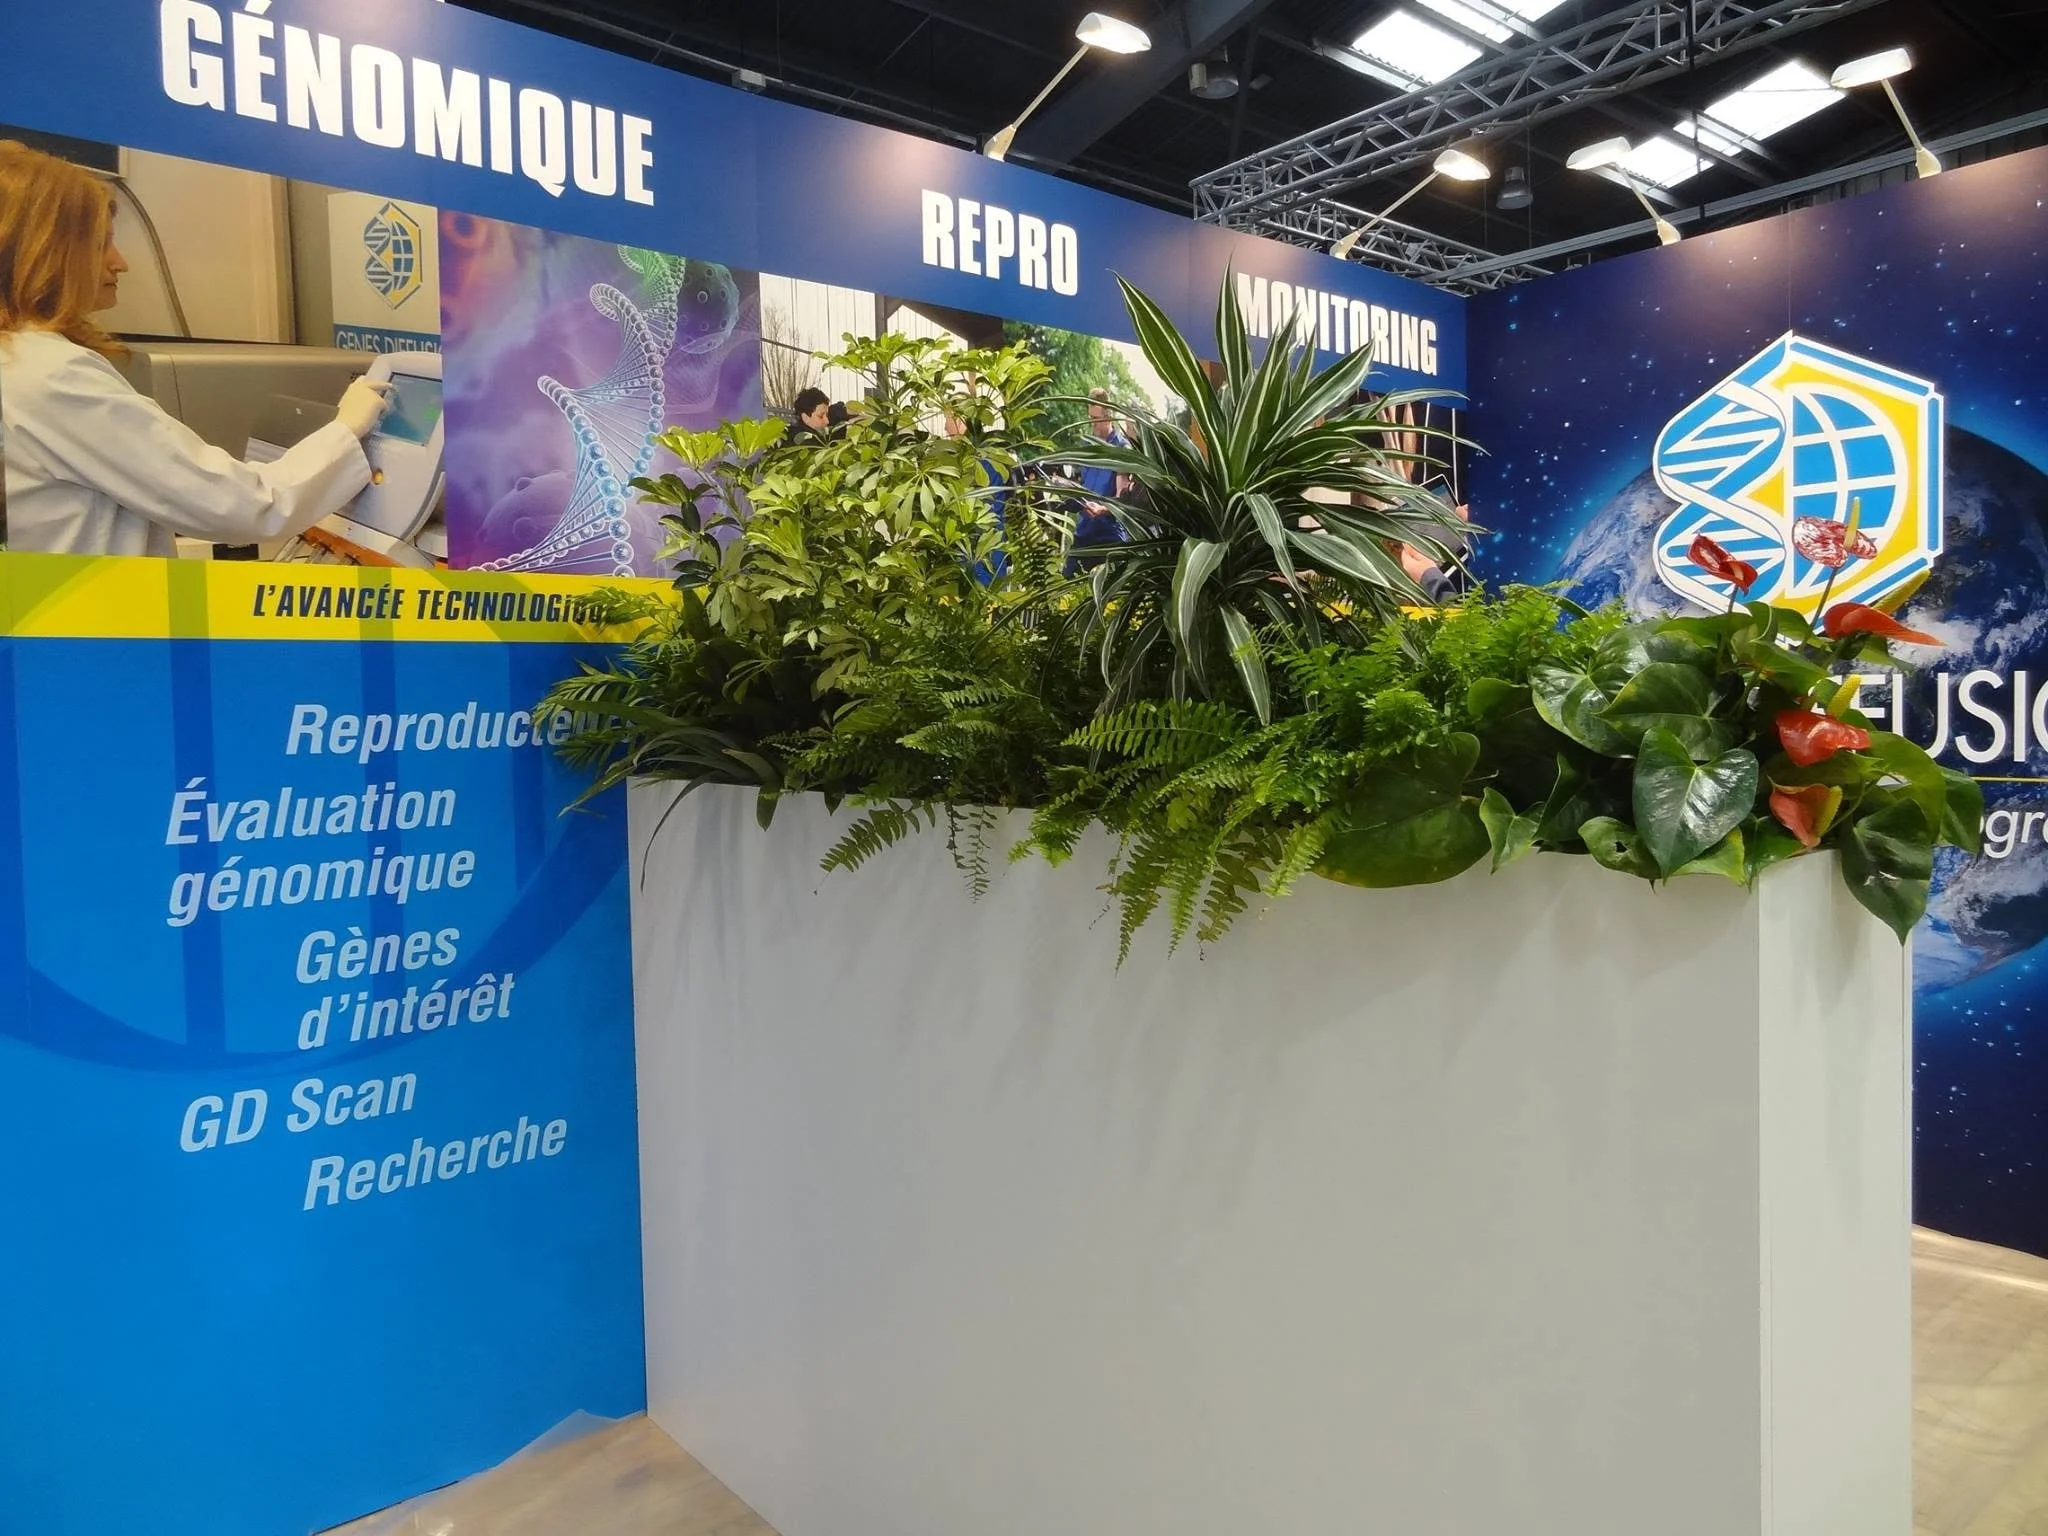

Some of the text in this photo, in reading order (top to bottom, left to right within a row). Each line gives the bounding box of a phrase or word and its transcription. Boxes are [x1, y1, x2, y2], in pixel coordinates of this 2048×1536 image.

[160, 0, 655, 206] GÉNOMIQUE
[921, 188, 1079, 296] REPRO
[1237, 272, 1438, 376] MONITORING
[253, 584, 606, 626] L'AVANCÉE TECHNOLOGIQU
[286, 701, 637, 764] Reproducteu
[165, 776, 456, 845] Évaluation
[166, 847, 475, 927] génomique
[296, 926, 460, 983] Gènes
[297, 973, 515, 1050] d'intérêt
[180, 1073, 417, 1153] GD Scan
[303, 1116, 568, 1211] Recherche
